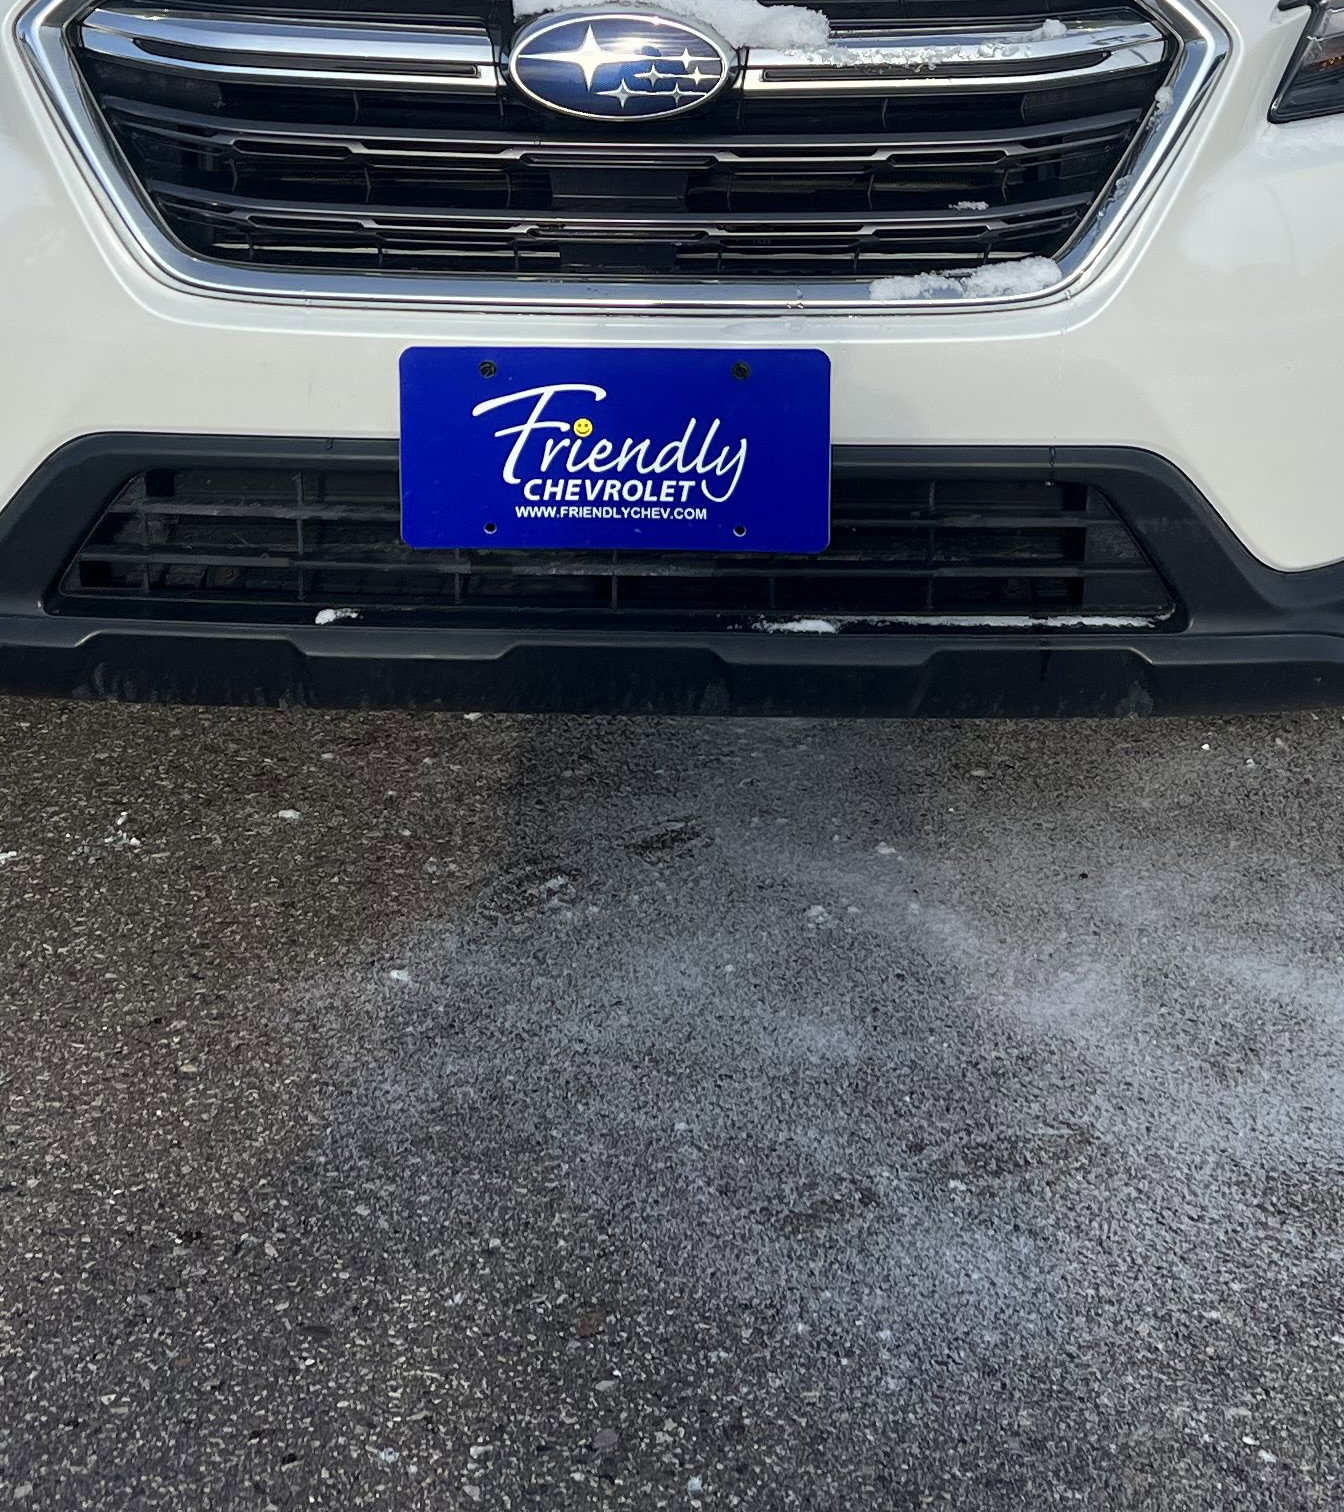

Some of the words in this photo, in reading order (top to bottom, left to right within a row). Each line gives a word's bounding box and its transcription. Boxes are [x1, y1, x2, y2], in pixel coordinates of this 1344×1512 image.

[472, 383, 747, 502] Friendly
[523, 478, 695, 502] CHEVROLET
[515, 505, 707, 520] WWW.FRIENDLYCHEV.COM
